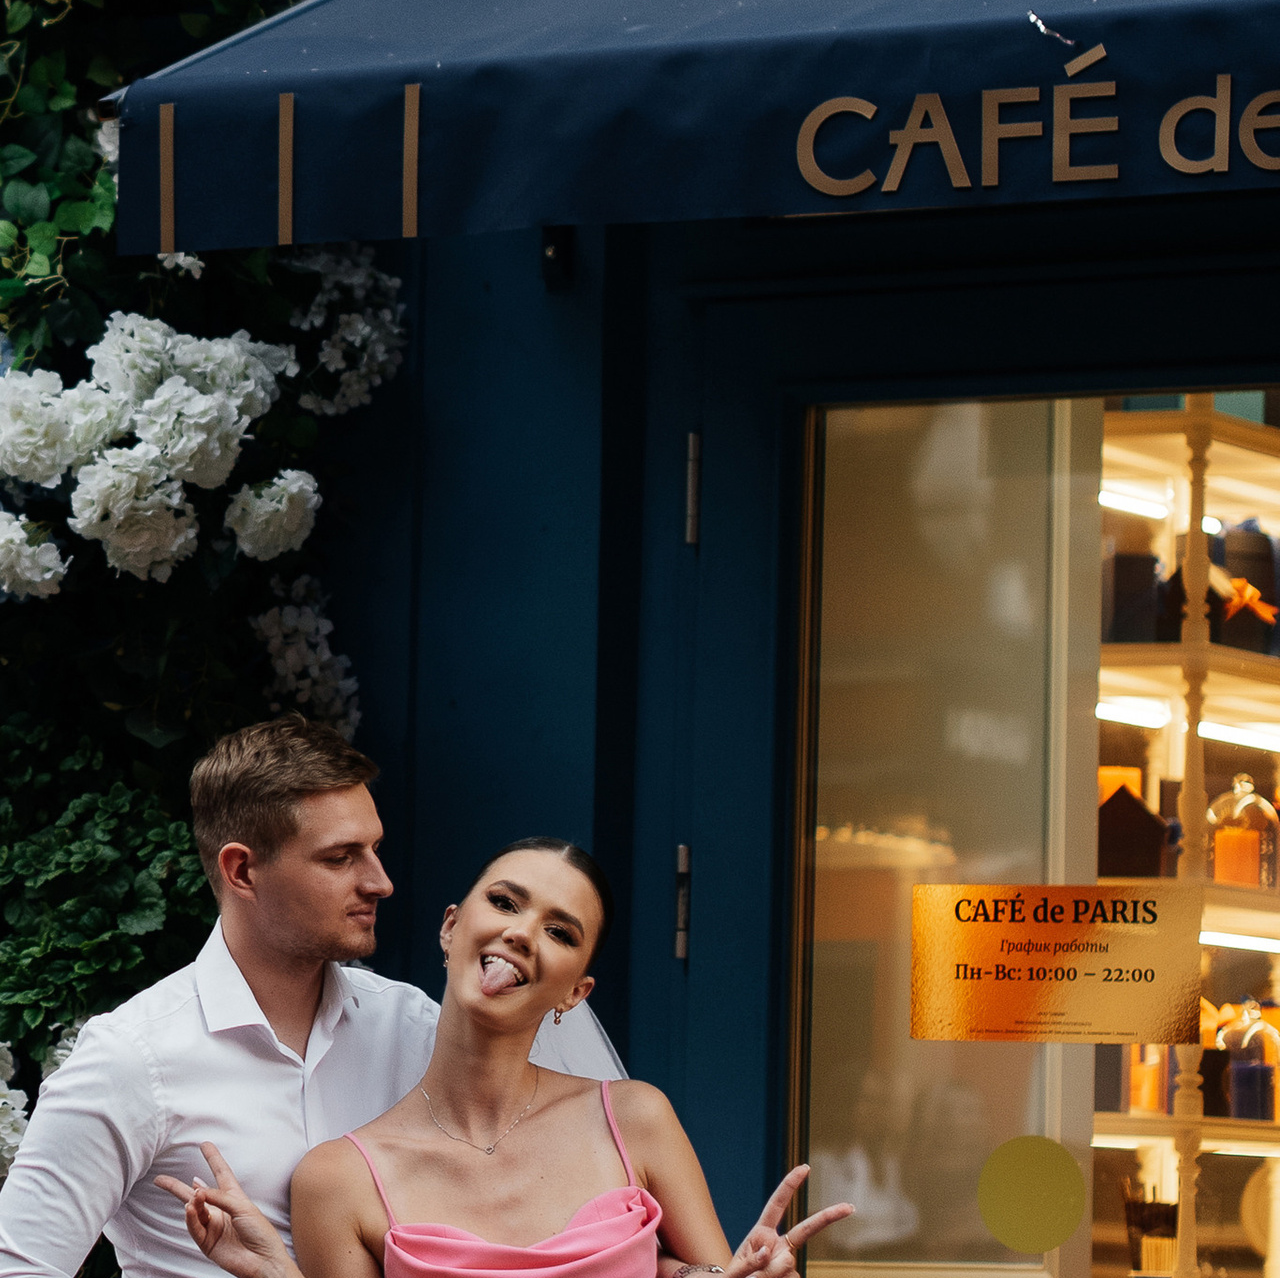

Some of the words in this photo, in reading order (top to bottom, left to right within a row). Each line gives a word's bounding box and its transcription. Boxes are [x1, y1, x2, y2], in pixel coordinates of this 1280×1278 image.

[796, 43, 1119, 196] CAFÉ
[954, 893, 1025, 923] CAFÉ
[1033, 897, 1065, 923] de
[1072, 899, 1158, 924] PARIS
[1000, 939, 1051, 955] График
[1054, 939, 1109, 954] работы
[954, 964, 1022, 981] Пн-Вс:
[1027, 967, 1077, 982] 10:00
[1103, 968, 1155, 983] 22:00
